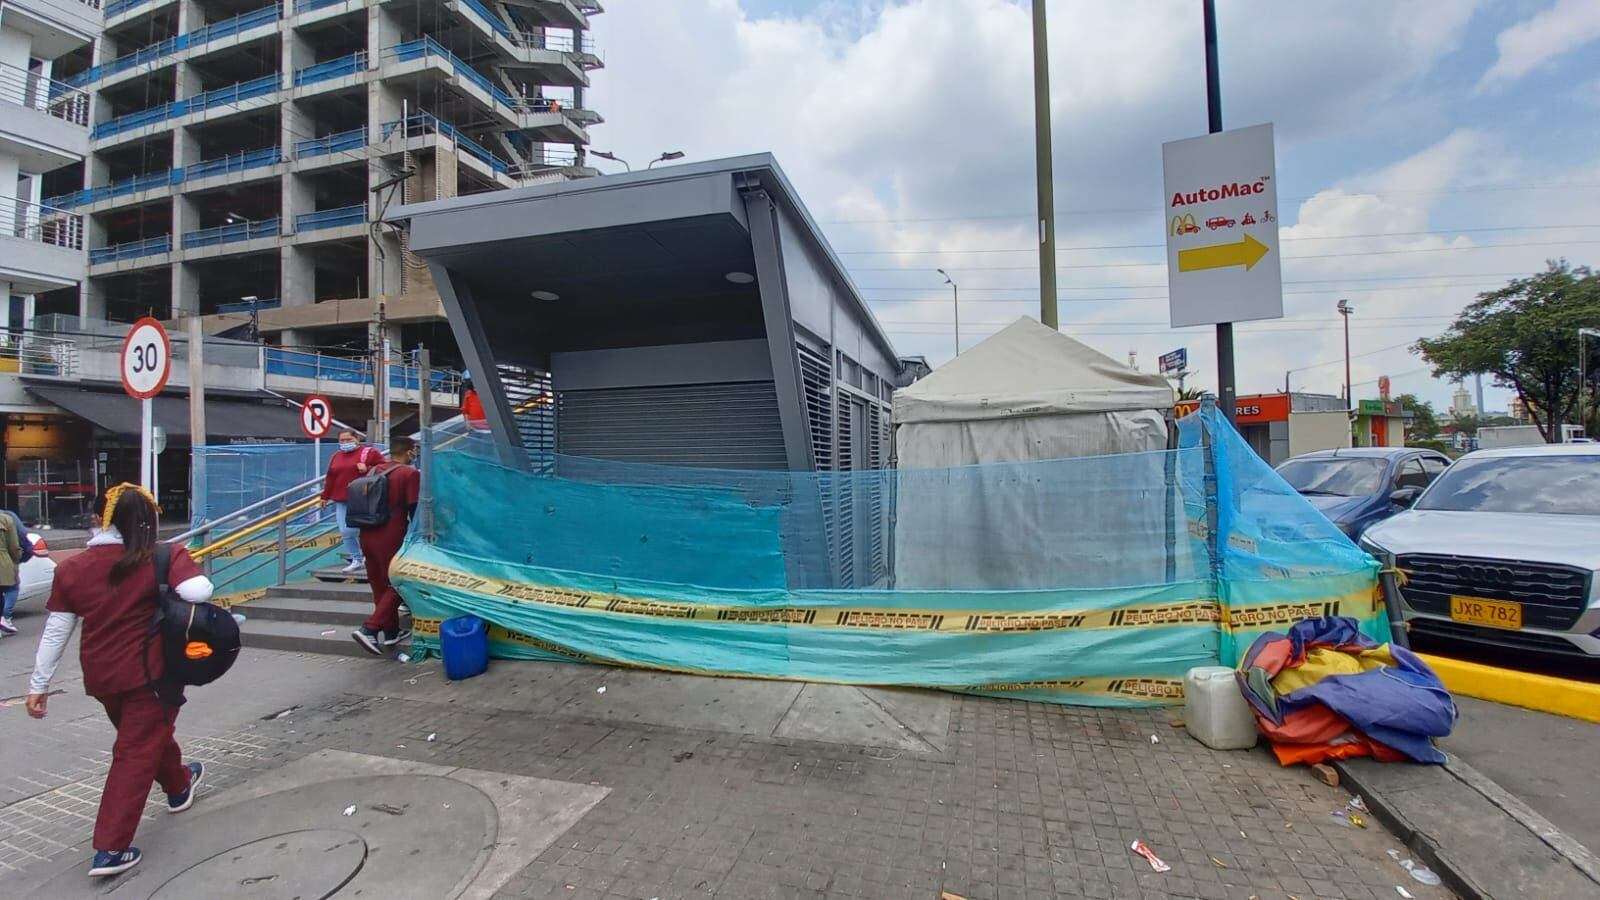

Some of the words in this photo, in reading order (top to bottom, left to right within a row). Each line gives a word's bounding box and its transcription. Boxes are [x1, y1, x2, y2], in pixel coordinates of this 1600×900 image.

[132, 342, 158, 374] 30
[1235, 405, 1260, 416] RES
[1126, 612, 1173, 622] PELIGRO
[1176, 610, 1192, 619] NO
[1231, 612, 1265, 623] LIGRO
[1268, 610, 1285, 620] NO
[1287, 607, 1319, 617] PASE
[1454, 601, 1482, 617] JXR
[1487, 605, 1518, 622] 782
[849, 615, 888, 624] PELIGRO
[889, 617, 903, 625] NO
[905, 617, 929, 626] PASE
[980, 618, 1024, 627] PELIGRO
[1025, 619, 1039, 627] NO
[1041, 619, 1068, 627] PASE
[1124, 681, 1172, 695] PELIGRO
[1175, 686, 1184, 695] N
